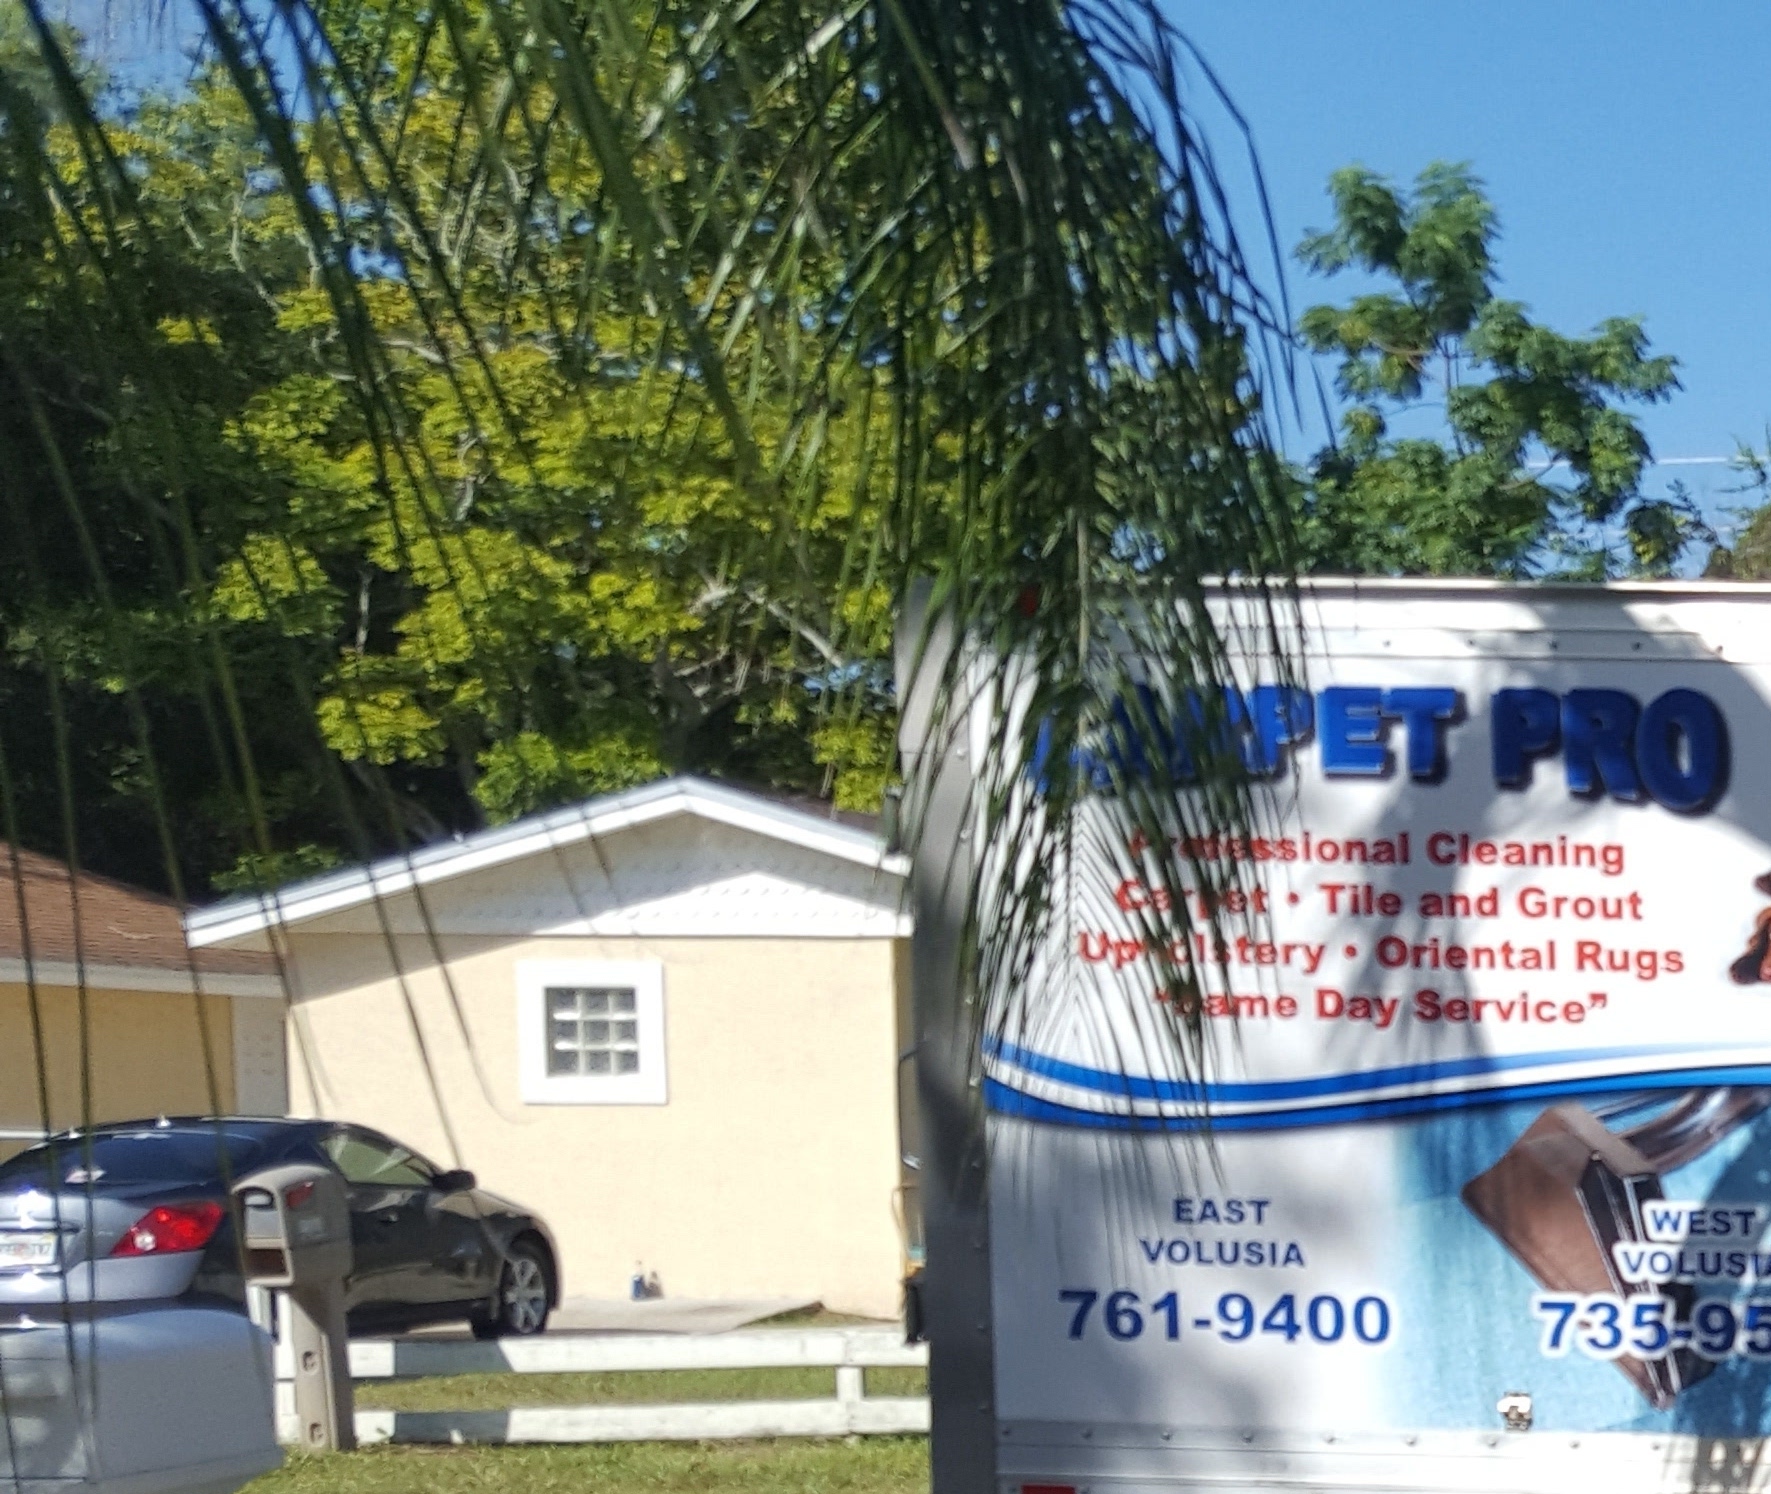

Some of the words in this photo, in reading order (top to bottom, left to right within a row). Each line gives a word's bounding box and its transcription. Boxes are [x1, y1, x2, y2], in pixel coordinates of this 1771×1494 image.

[1492, 685, 1730, 816] PRO
[1426, 831, 1624, 876] Cleaning
[1115, 879, 1268, 919] Capet
[1320, 882, 1401, 918] Tile
[1418, 886, 1498, 919] and
[1517, 886, 1643, 920] Grout
[1376, 935, 1555, 970] Oriental
[1575, 941, 1684, 980] Rugs
[1316, 989, 1399, 1028] Day
[1173, 1199, 1270, 1225] EAST
[1650, 1208, 1756, 1236] WEST
[1139, 1239, 1305, 1268] VOLUSIA
[1058, 1288, 1391, 1344] 761-9400
